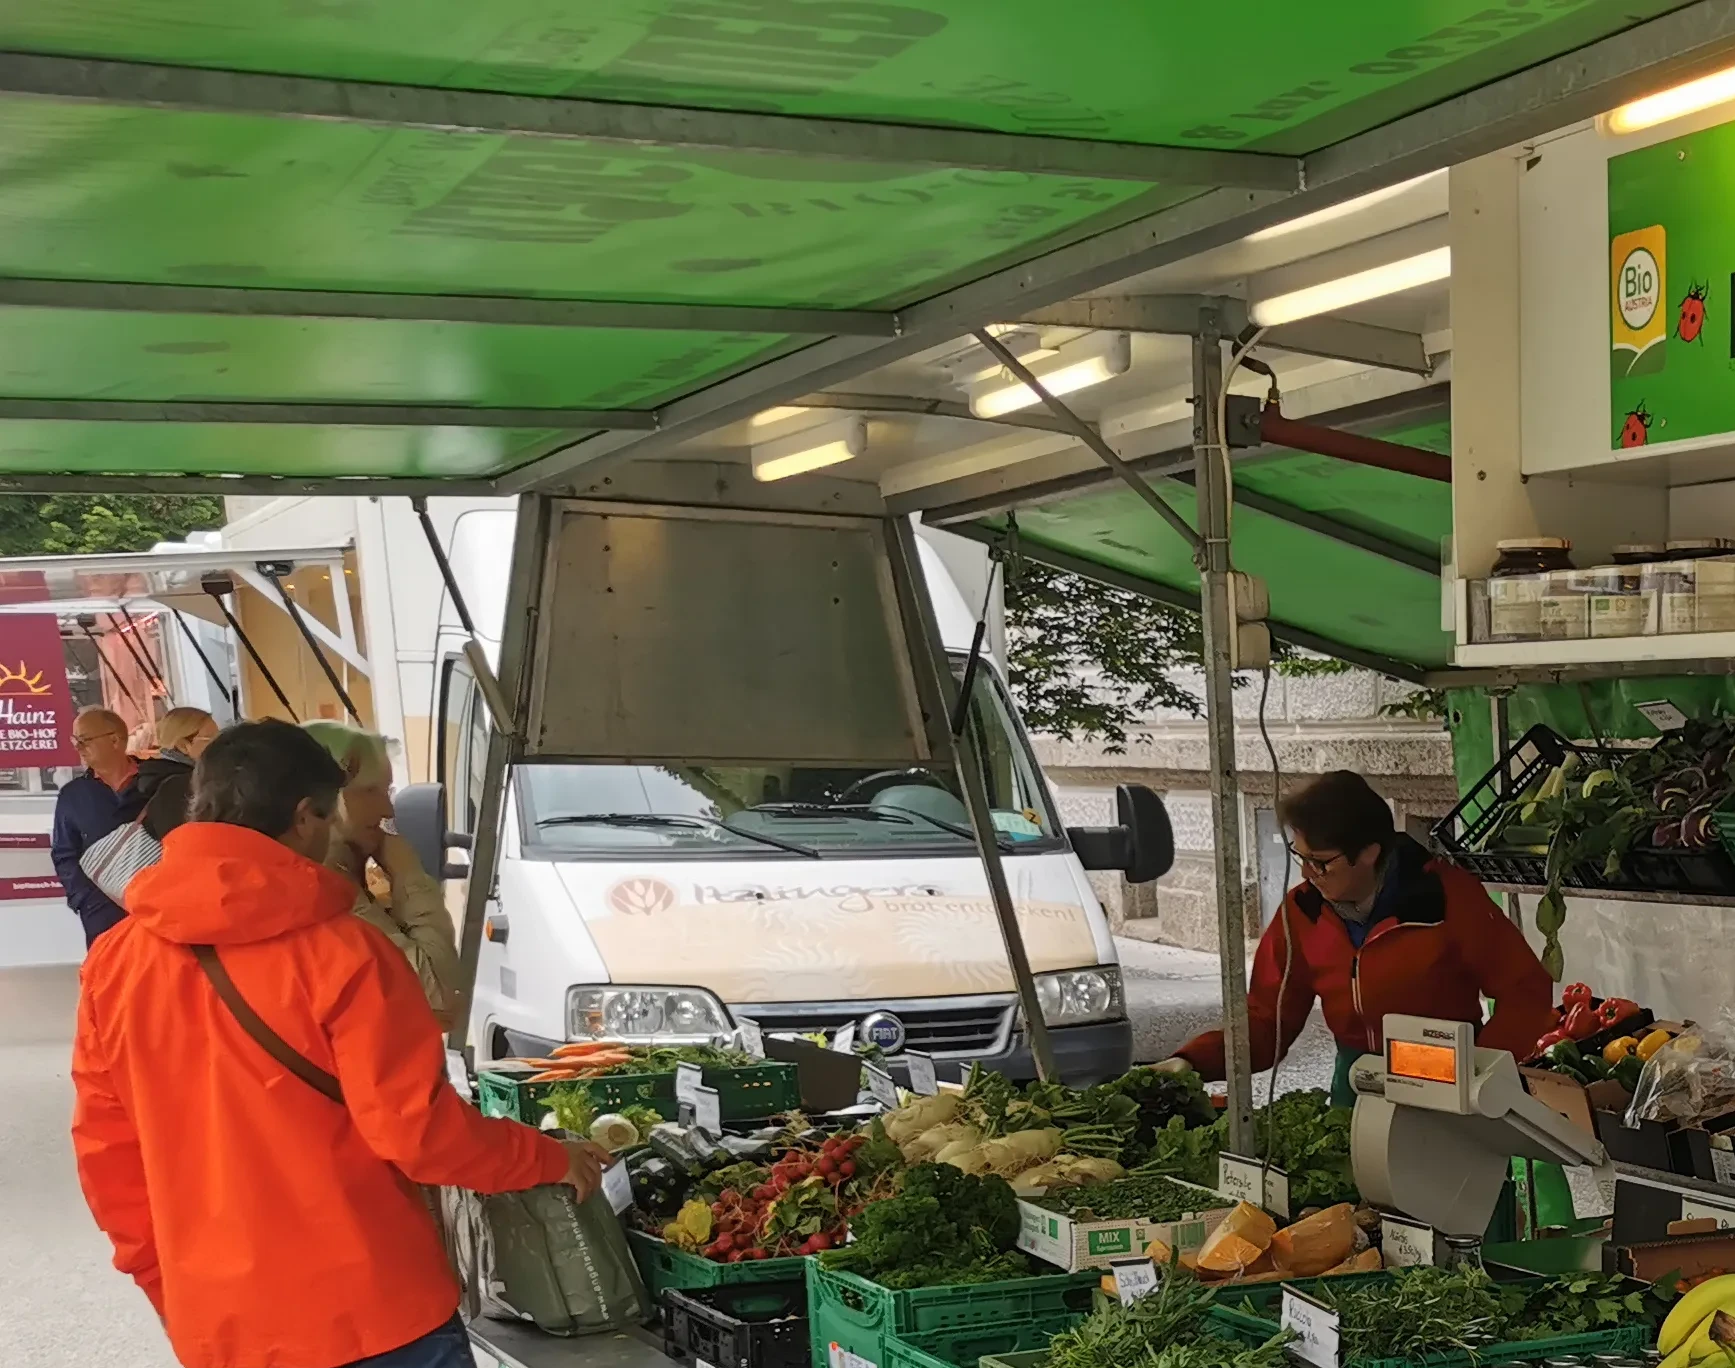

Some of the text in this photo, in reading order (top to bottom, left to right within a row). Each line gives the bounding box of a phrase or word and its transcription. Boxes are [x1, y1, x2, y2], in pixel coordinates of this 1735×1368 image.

[1625, 263, 1652, 298] Bio
[1624, 295, 1653, 313] AUSTRIA
[7, 728, 57, 740] BIO-HOF
[872, 1026, 899, 1040] FIAT
[1099, 1231, 1121, 1244] MIX
